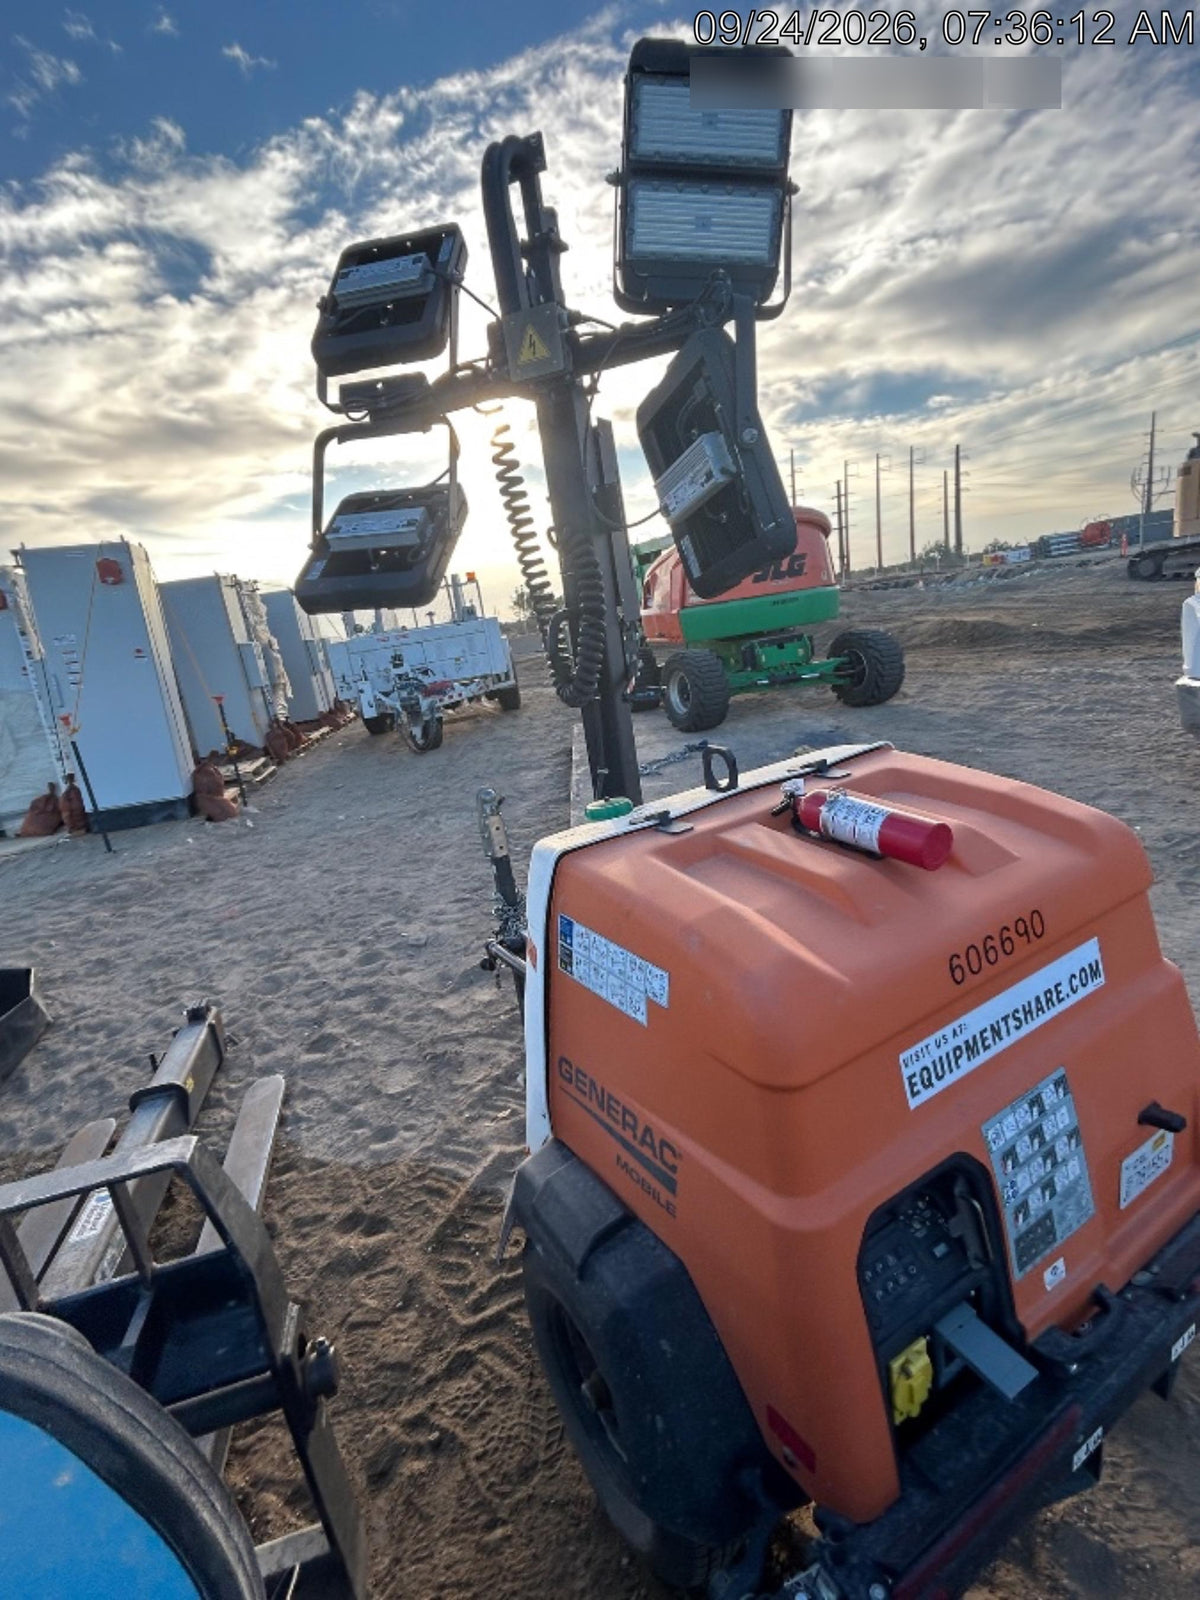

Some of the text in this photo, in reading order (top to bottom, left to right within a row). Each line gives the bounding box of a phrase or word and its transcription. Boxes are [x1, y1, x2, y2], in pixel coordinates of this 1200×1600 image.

[949, 909, 1045, 985] 606690
[902, 1023, 968, 1069] VISIT US AT:
[906, 958, 1103, 1099] EQUIPMENTSHARE.COM
[558, 1056, 678, 1174] GENERAC
[616, 1153, 677, 1219] MOBILE
